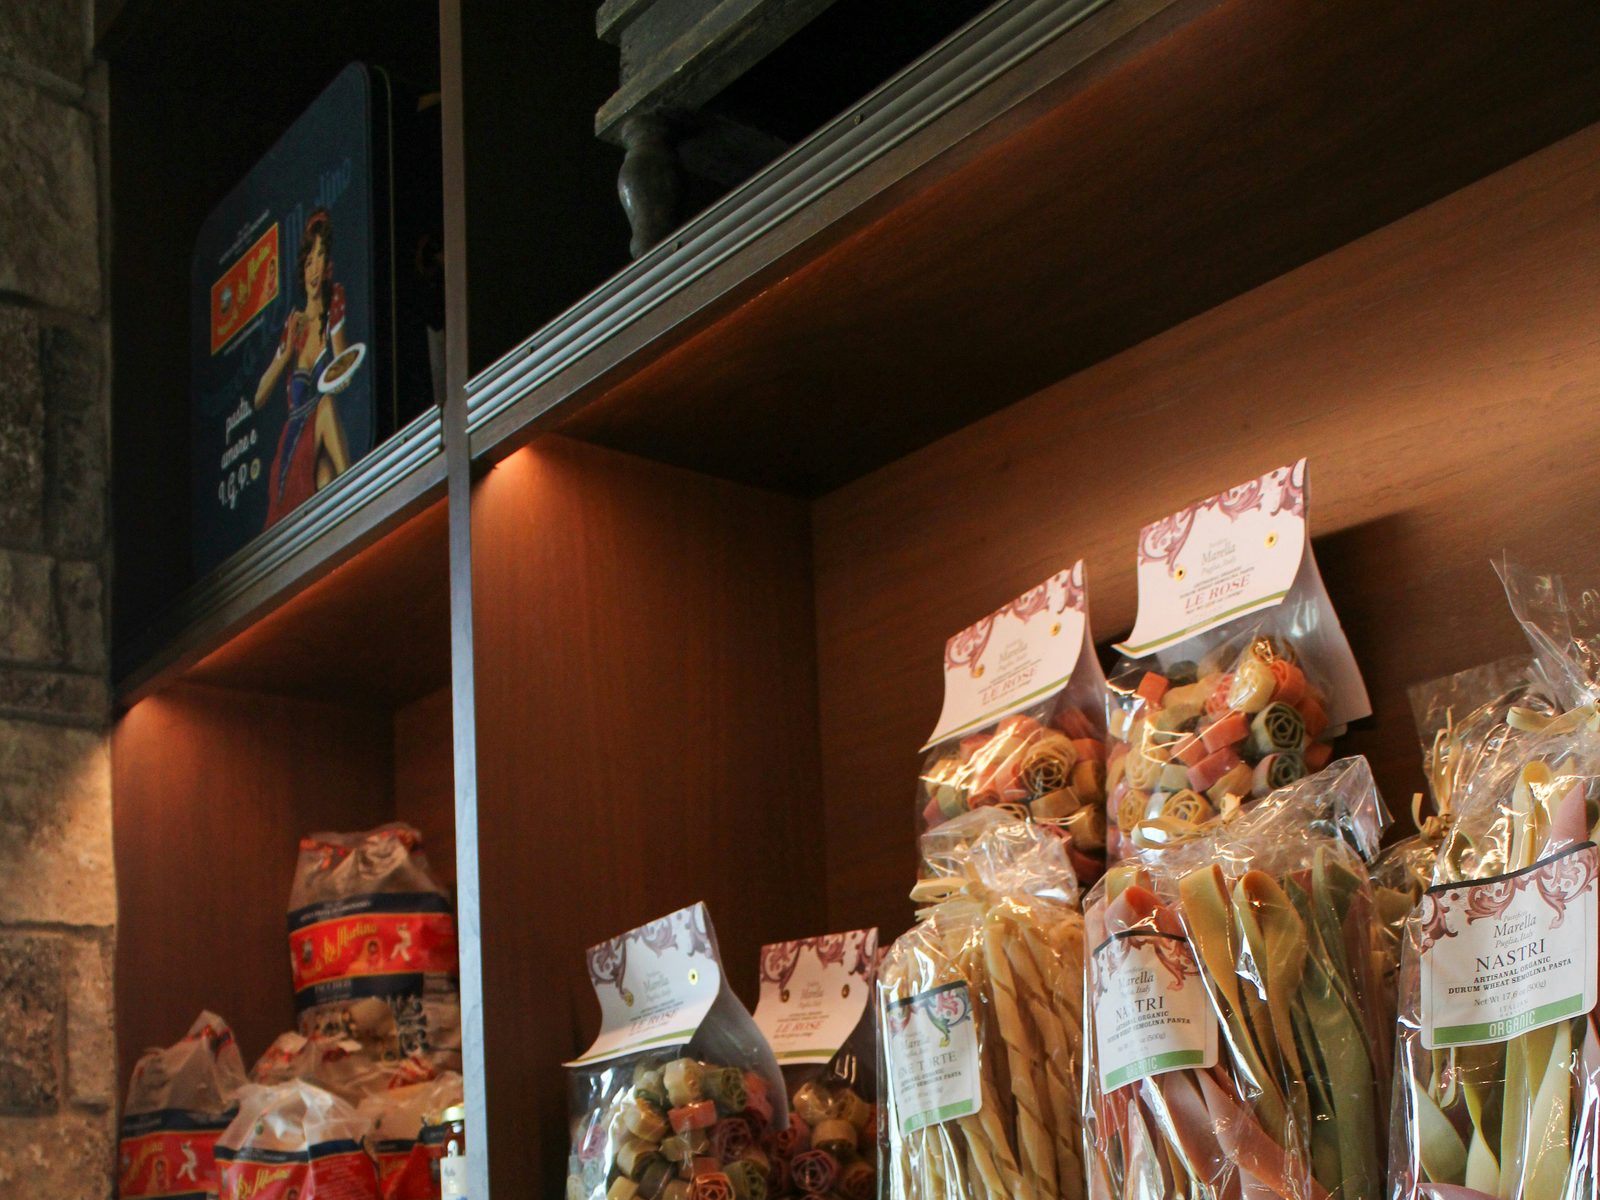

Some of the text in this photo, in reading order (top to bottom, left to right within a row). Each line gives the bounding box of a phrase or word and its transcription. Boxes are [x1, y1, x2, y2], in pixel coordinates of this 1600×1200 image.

[1209, 573, 1251, 601] ROSE
[1003, 666, 1037, 691] ROSE
[1493, 915, 1537, 939] Marella
[1475, 938, 1547, 973] NASTRI
[1448, 958, 1573, 995] DURUM WHEAT SEMOLINA PASTA
[1473, 956, 1552, 985] ARTISANAL ORGANIC
[648, 1007, 678, 1026] ROSE
[1115, 995, 1165, 1020] NATRI
[1137, 1010, 1170, 1022] ORGANIC
[791, 1019, 822, 1032] ROSE
[1166, 1017, 1191, 1025] PASTA
[1489, 1010, 1537, 1038] ORGANIC
